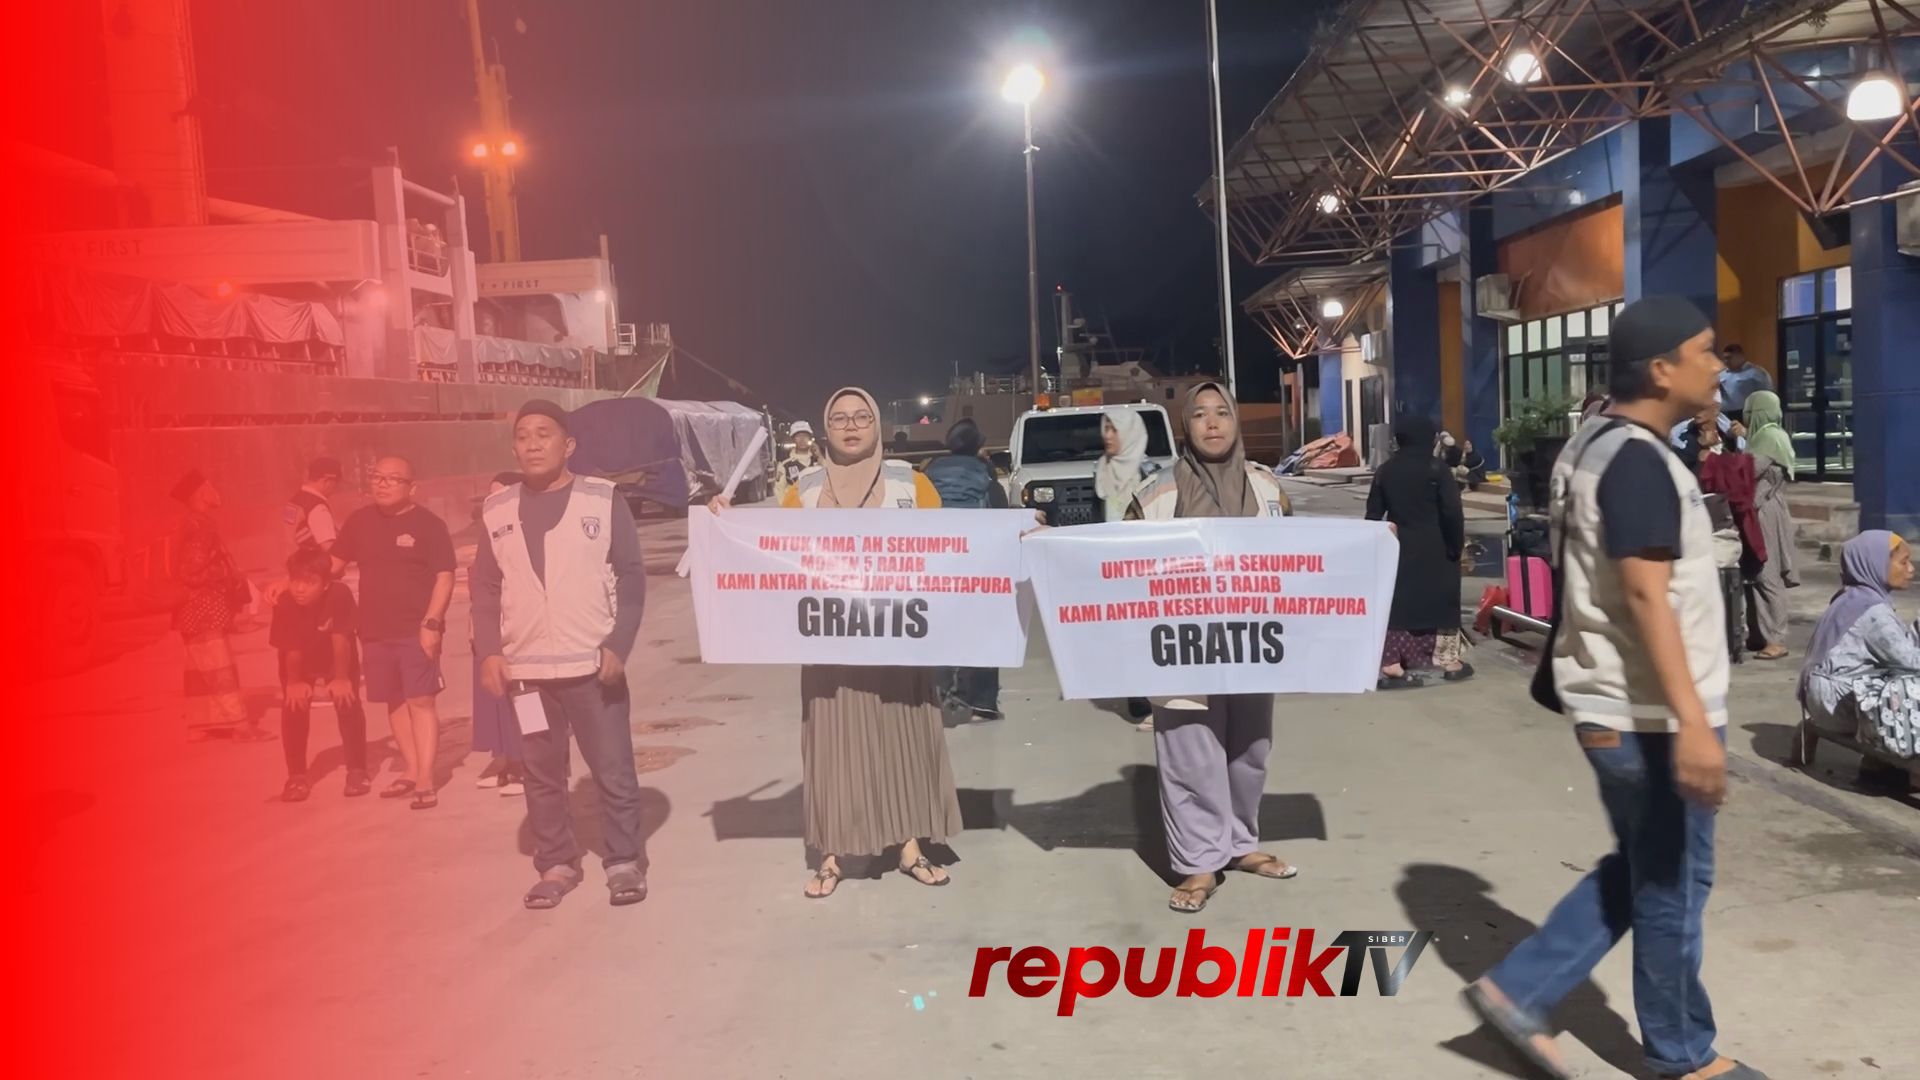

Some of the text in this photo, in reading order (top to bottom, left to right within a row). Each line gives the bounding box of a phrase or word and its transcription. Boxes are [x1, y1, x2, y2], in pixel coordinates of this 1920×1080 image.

[86, 239, 144, 257] FIRST
[759, 535, 812, 552] UNTUK
[887, 536, 969, 554] SEKUMPUL
[864, 555, 873, 573] 5
[877, 555, 926, 573] RAJAB
[1102, 558, 1157, 579] UNTUK
[1239, 554, 1325, 573] SEKUMPUL
[717, 573, 1012, 594] KAMI ANTAR KEUMPUL MARTAPURA
[1149, 575, 1281, 597] MOMEN 5 RAJAB
[797, 596, 929, 639] GRATIS
[1059, 596, 1367, 623] KAMI ANTAR KESEKUMPUL MARTAPURA
[1150, 621, 1284, 667] GRATIS
